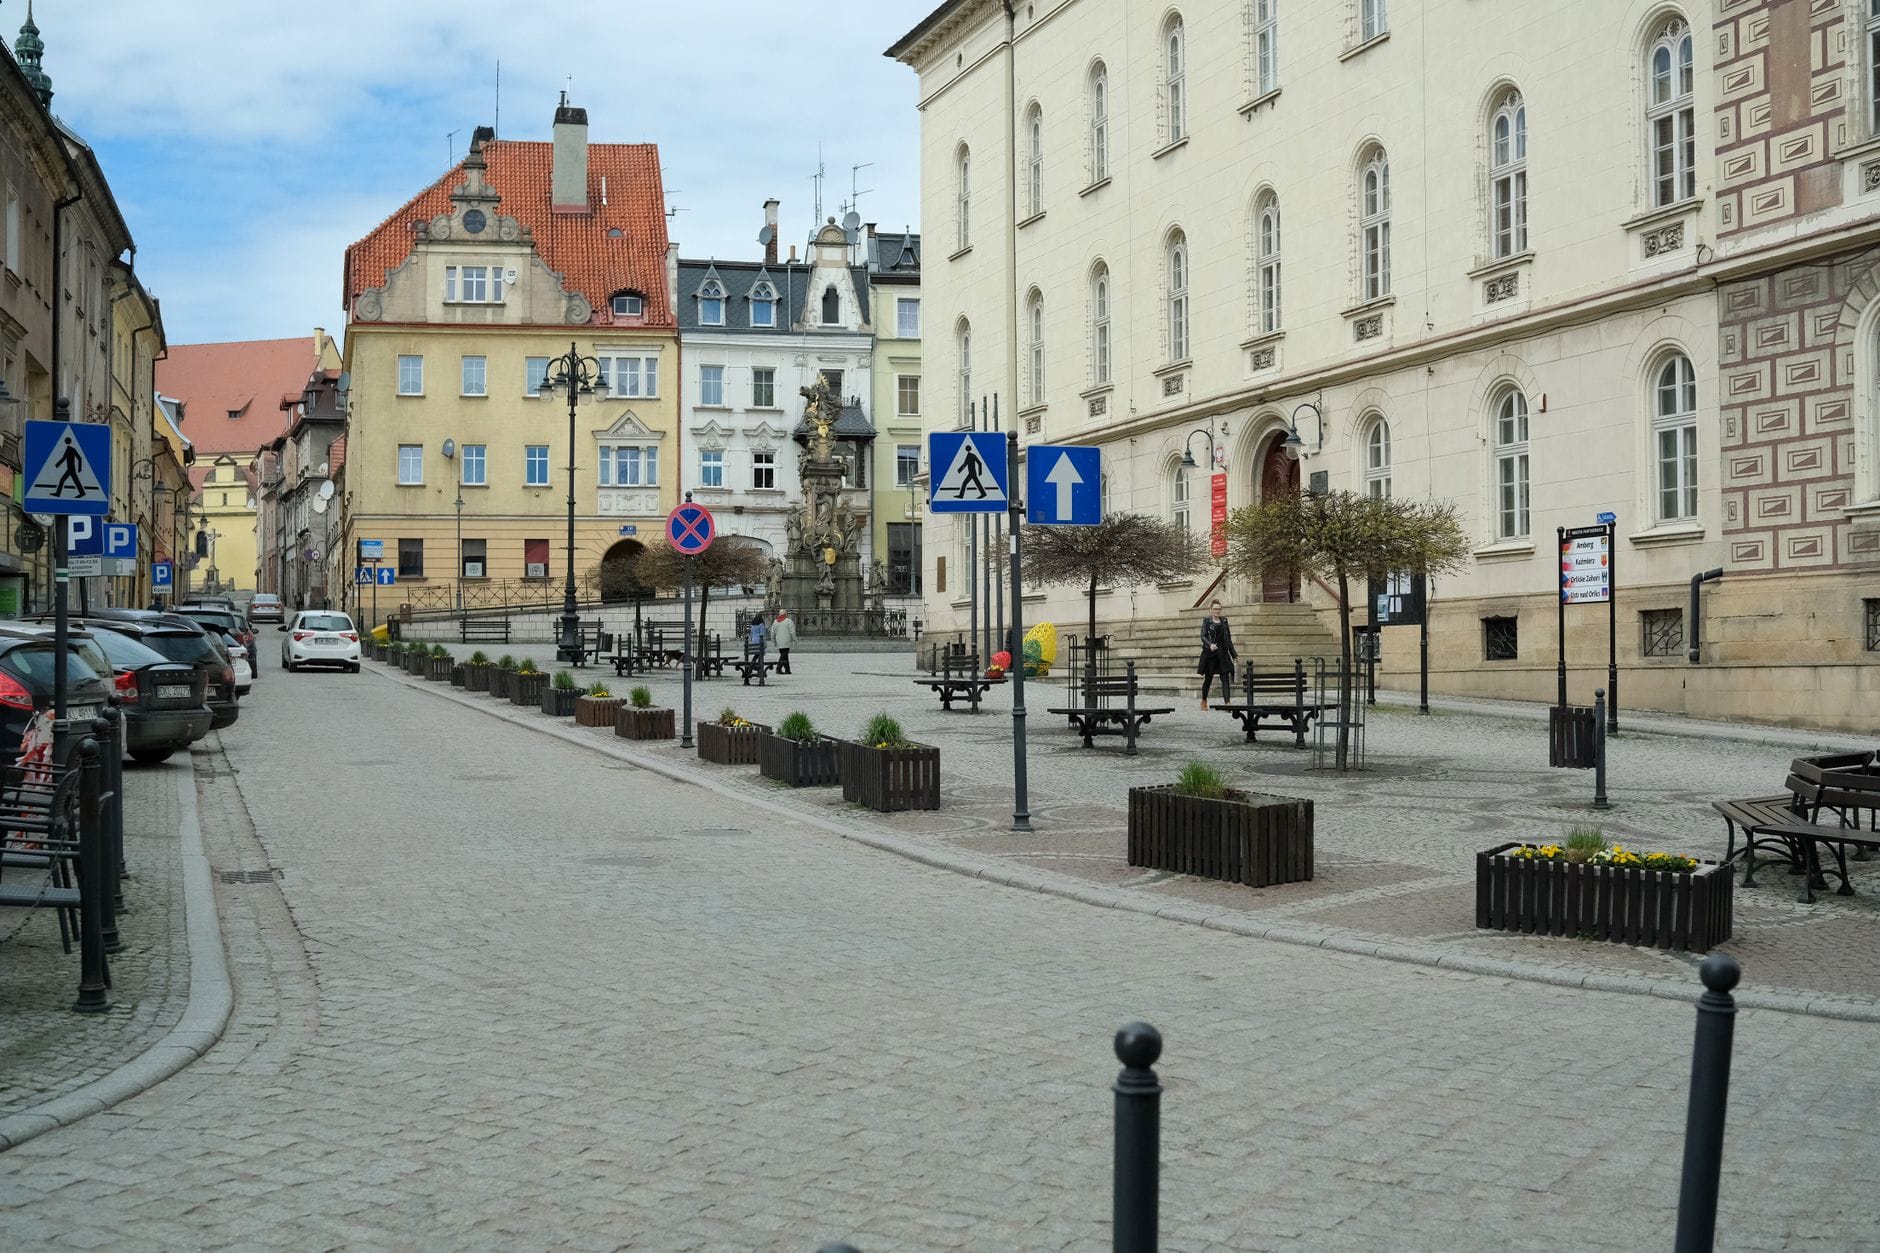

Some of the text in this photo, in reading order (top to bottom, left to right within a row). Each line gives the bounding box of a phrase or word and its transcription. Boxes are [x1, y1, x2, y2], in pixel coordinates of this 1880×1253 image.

[68, 516, 92, 550] P
[109, 527, 130, 554] P
[1576, 541, 1594, 550] Amberg
[156, 565, 168, 583] P
